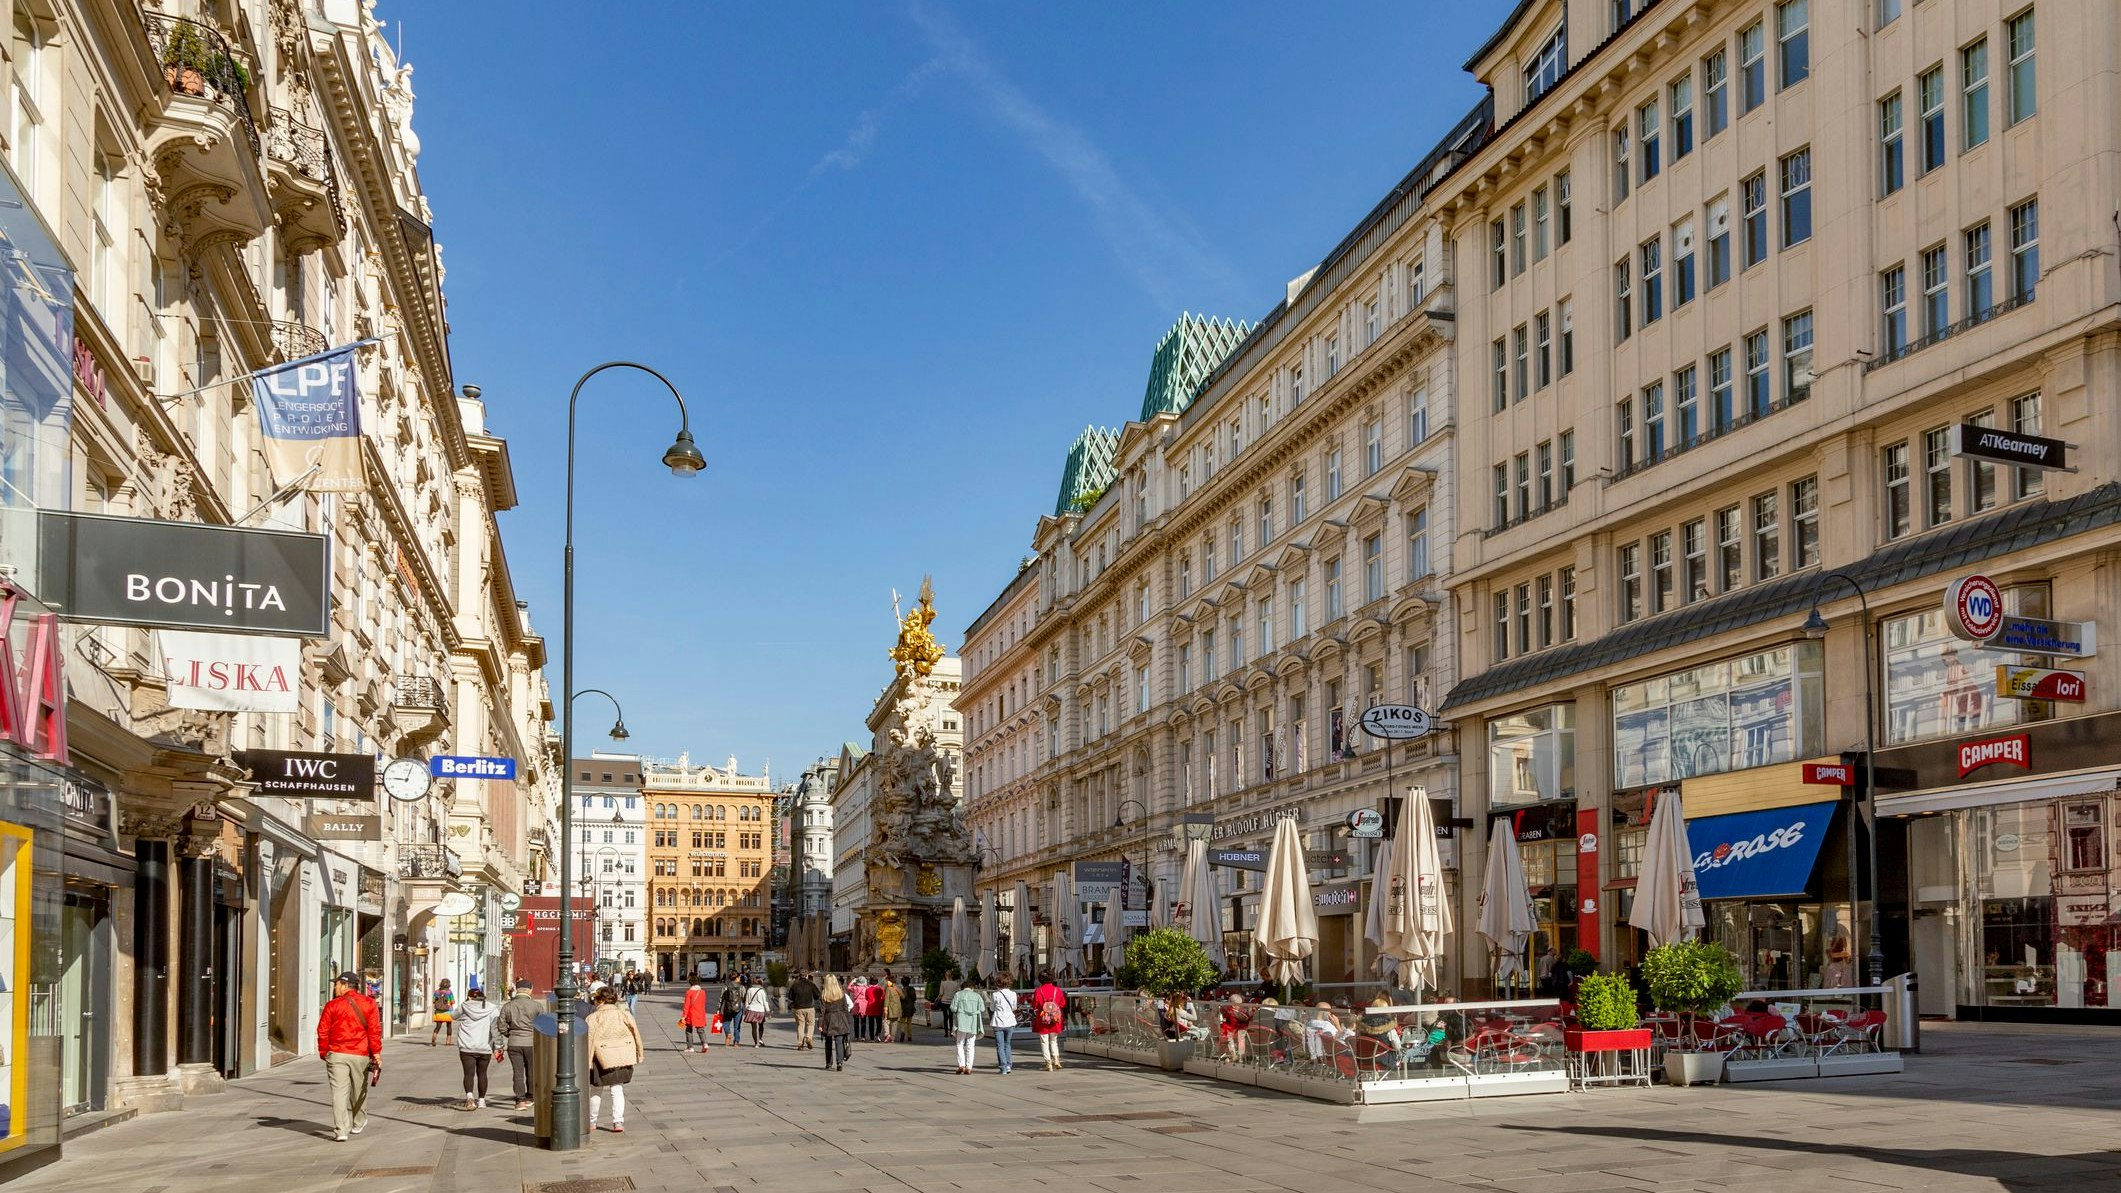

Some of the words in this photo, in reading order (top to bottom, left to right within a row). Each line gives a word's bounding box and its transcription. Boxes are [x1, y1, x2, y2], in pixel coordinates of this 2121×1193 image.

[1371, 708, 1423, 723] ZIKOS
[1960, 739, 2023, 768] CAMPER
[284, 758, 337, 779] IWC
[442, 758, 507, 776] Berlitz
[1816, 766, 1846, 782] CAMPER
[265, 781, 355, 792] SCHAFFHAUSEN
[323, 823, 365, 832] BALLY
[1226, 817, 1259, 837] RUDOLF
[1315, 889, 1348, 906] swatch
